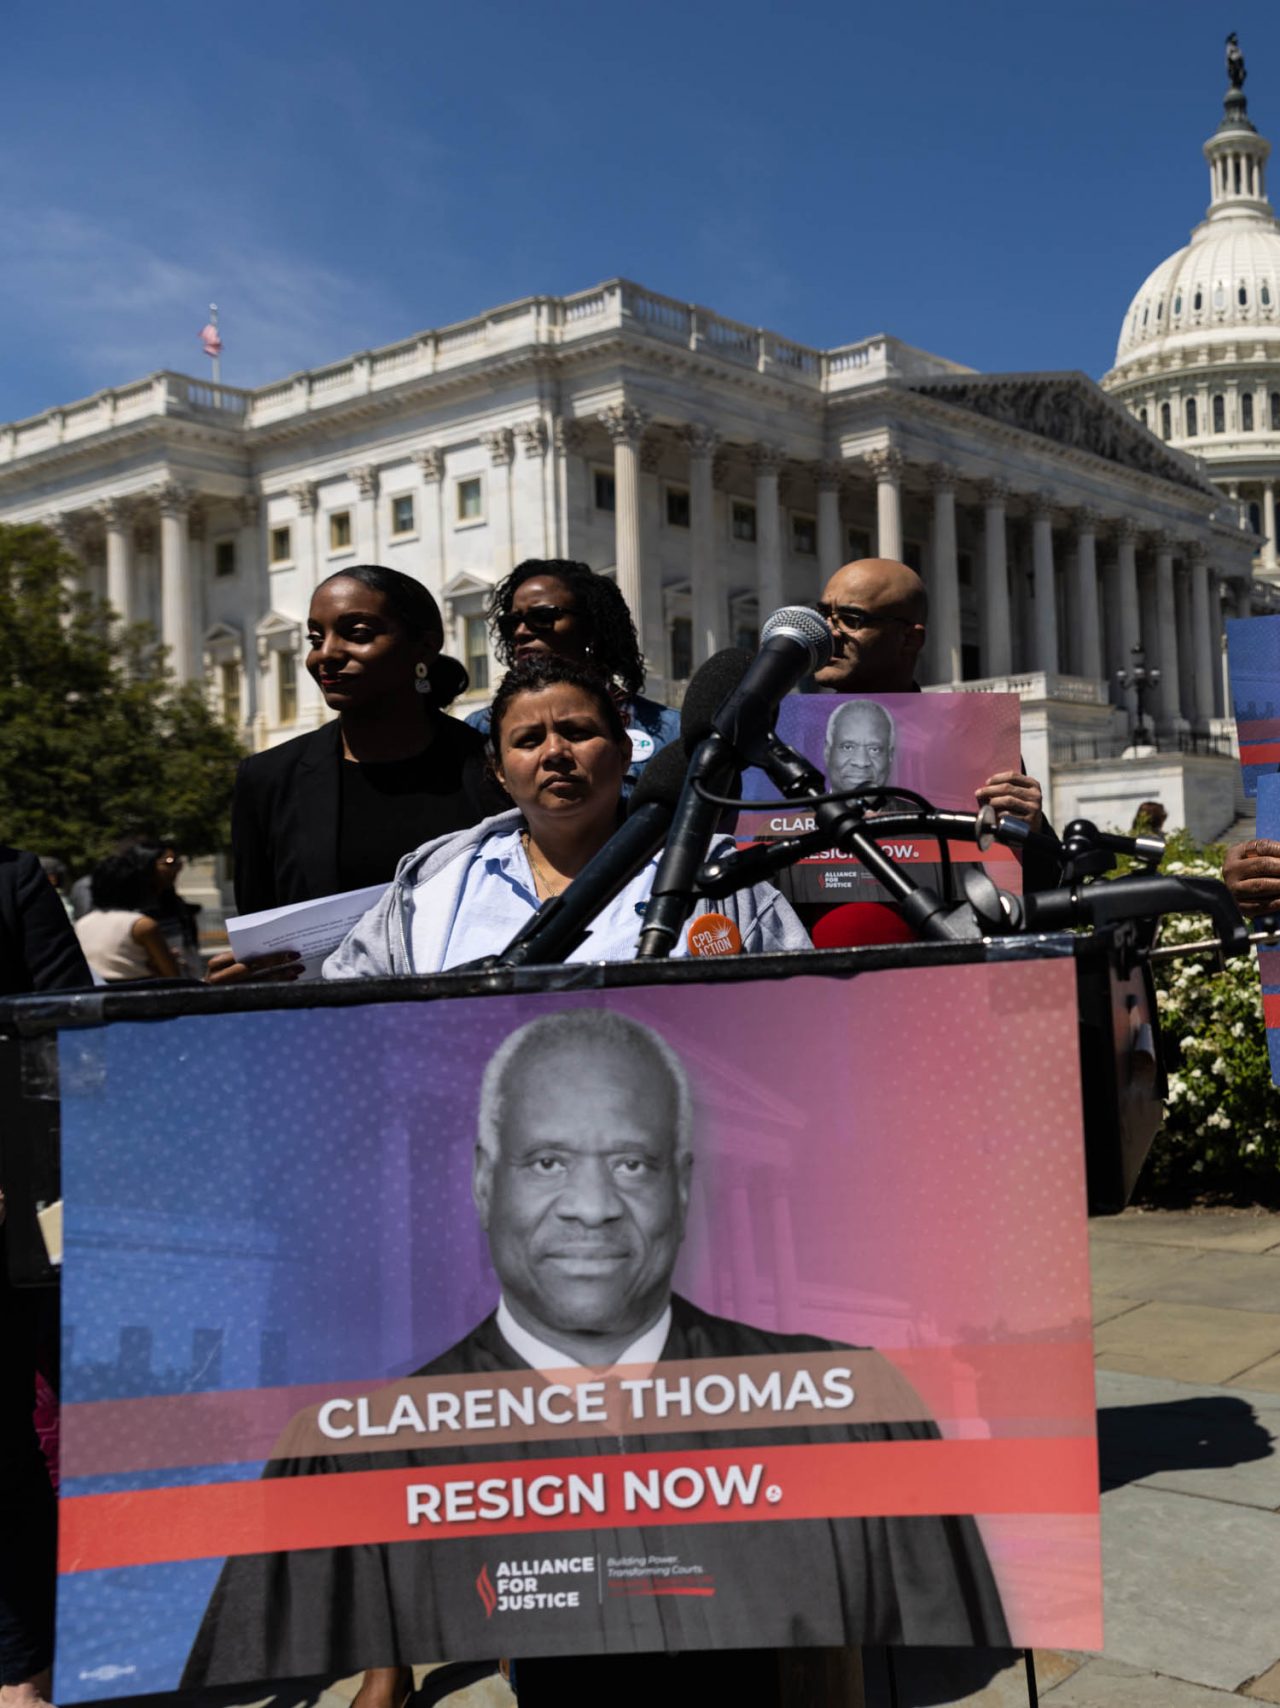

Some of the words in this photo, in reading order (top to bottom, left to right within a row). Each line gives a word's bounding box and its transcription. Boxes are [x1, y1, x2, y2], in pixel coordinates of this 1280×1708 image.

[770, 818, 819, 831] CLAR
[692, 931, 712, 948] CPD
[317, 1382, 608, 1439] CLARENCE
[622, 1367, 855, 1419] THOMAS
[405, 1471, 604, 1524] RESIGN
[623, 1463, 784, 1511] NOW.
[496, 1556, 594, 1577] ALLIANCE
[607, 1556, 647, 1567] Building
[607, 1565, 670, 1578] Transforming
[497, 1577, 538, 1594] FOR
[497, 1591, 580, 1611] JUSTICE
